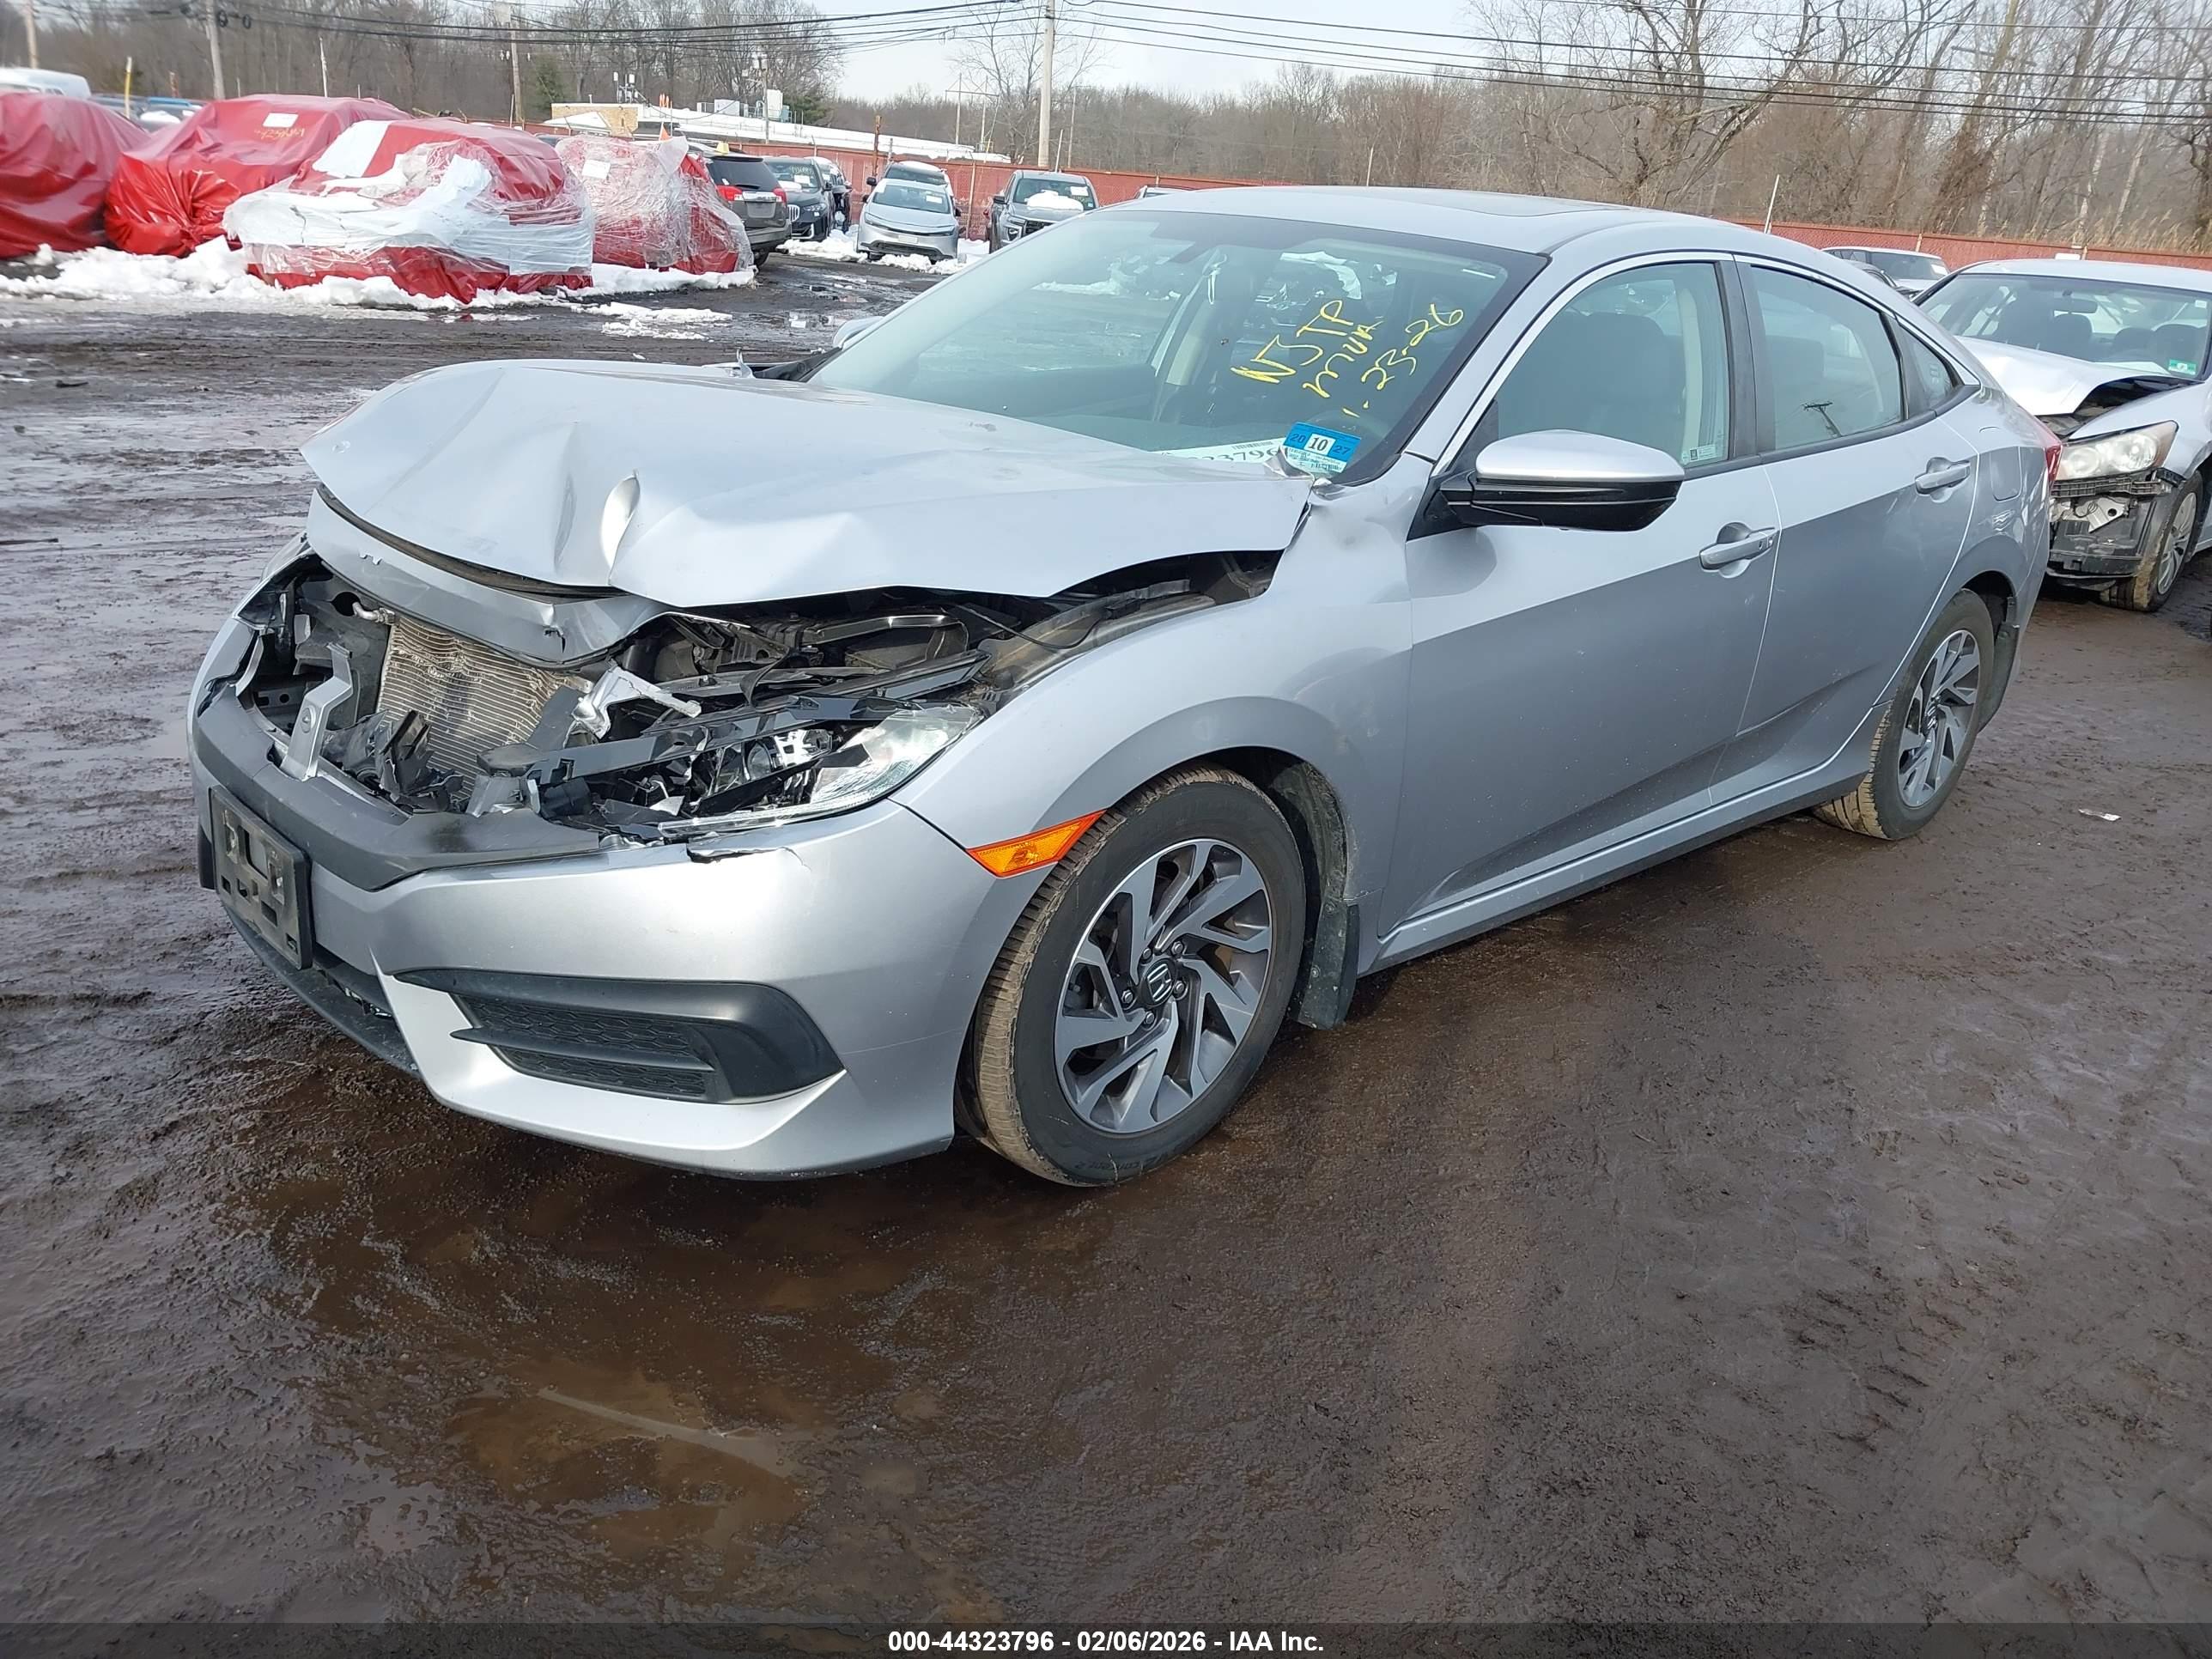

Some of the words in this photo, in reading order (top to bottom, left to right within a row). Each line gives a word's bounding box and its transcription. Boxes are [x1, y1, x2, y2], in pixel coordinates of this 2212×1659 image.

[1290, 432, 1306, 445] 20
[1308, 436, 1329, 452] 10
[1334, 444, 1350, 456] 27
